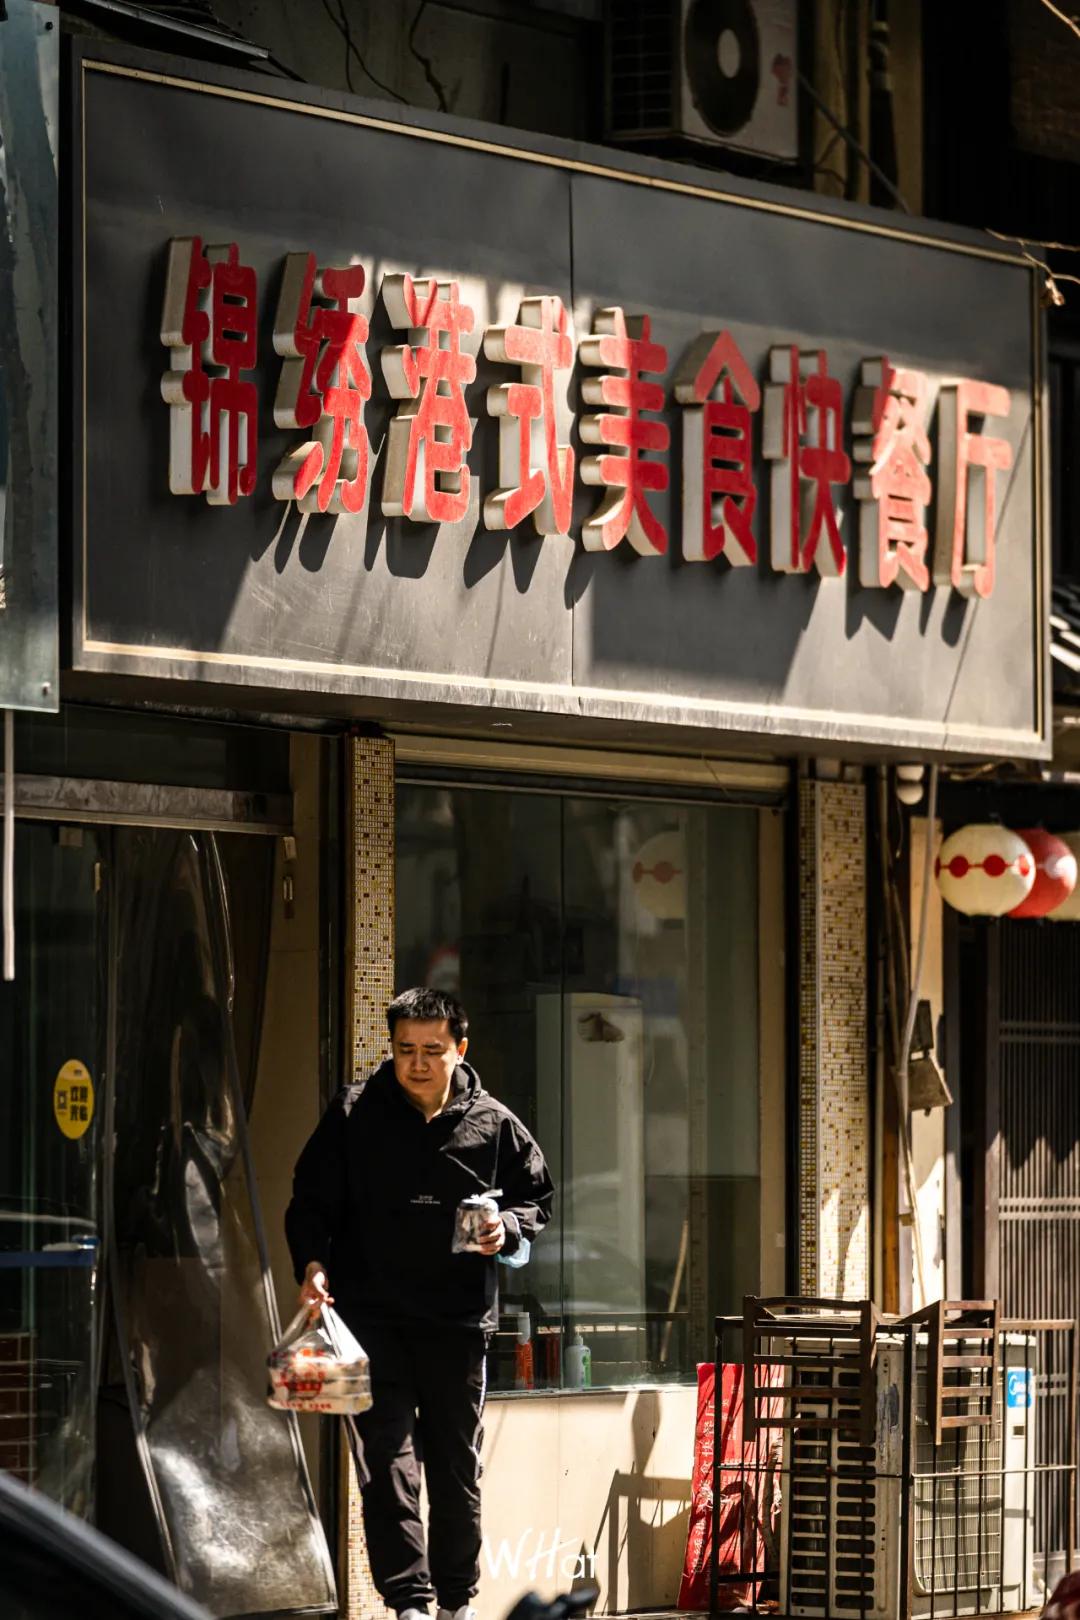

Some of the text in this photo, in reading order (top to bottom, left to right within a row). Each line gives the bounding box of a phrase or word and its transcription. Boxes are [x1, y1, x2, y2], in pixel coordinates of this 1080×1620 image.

[162, 236, 1012, 599] 锦绣港式美食快餐厅
